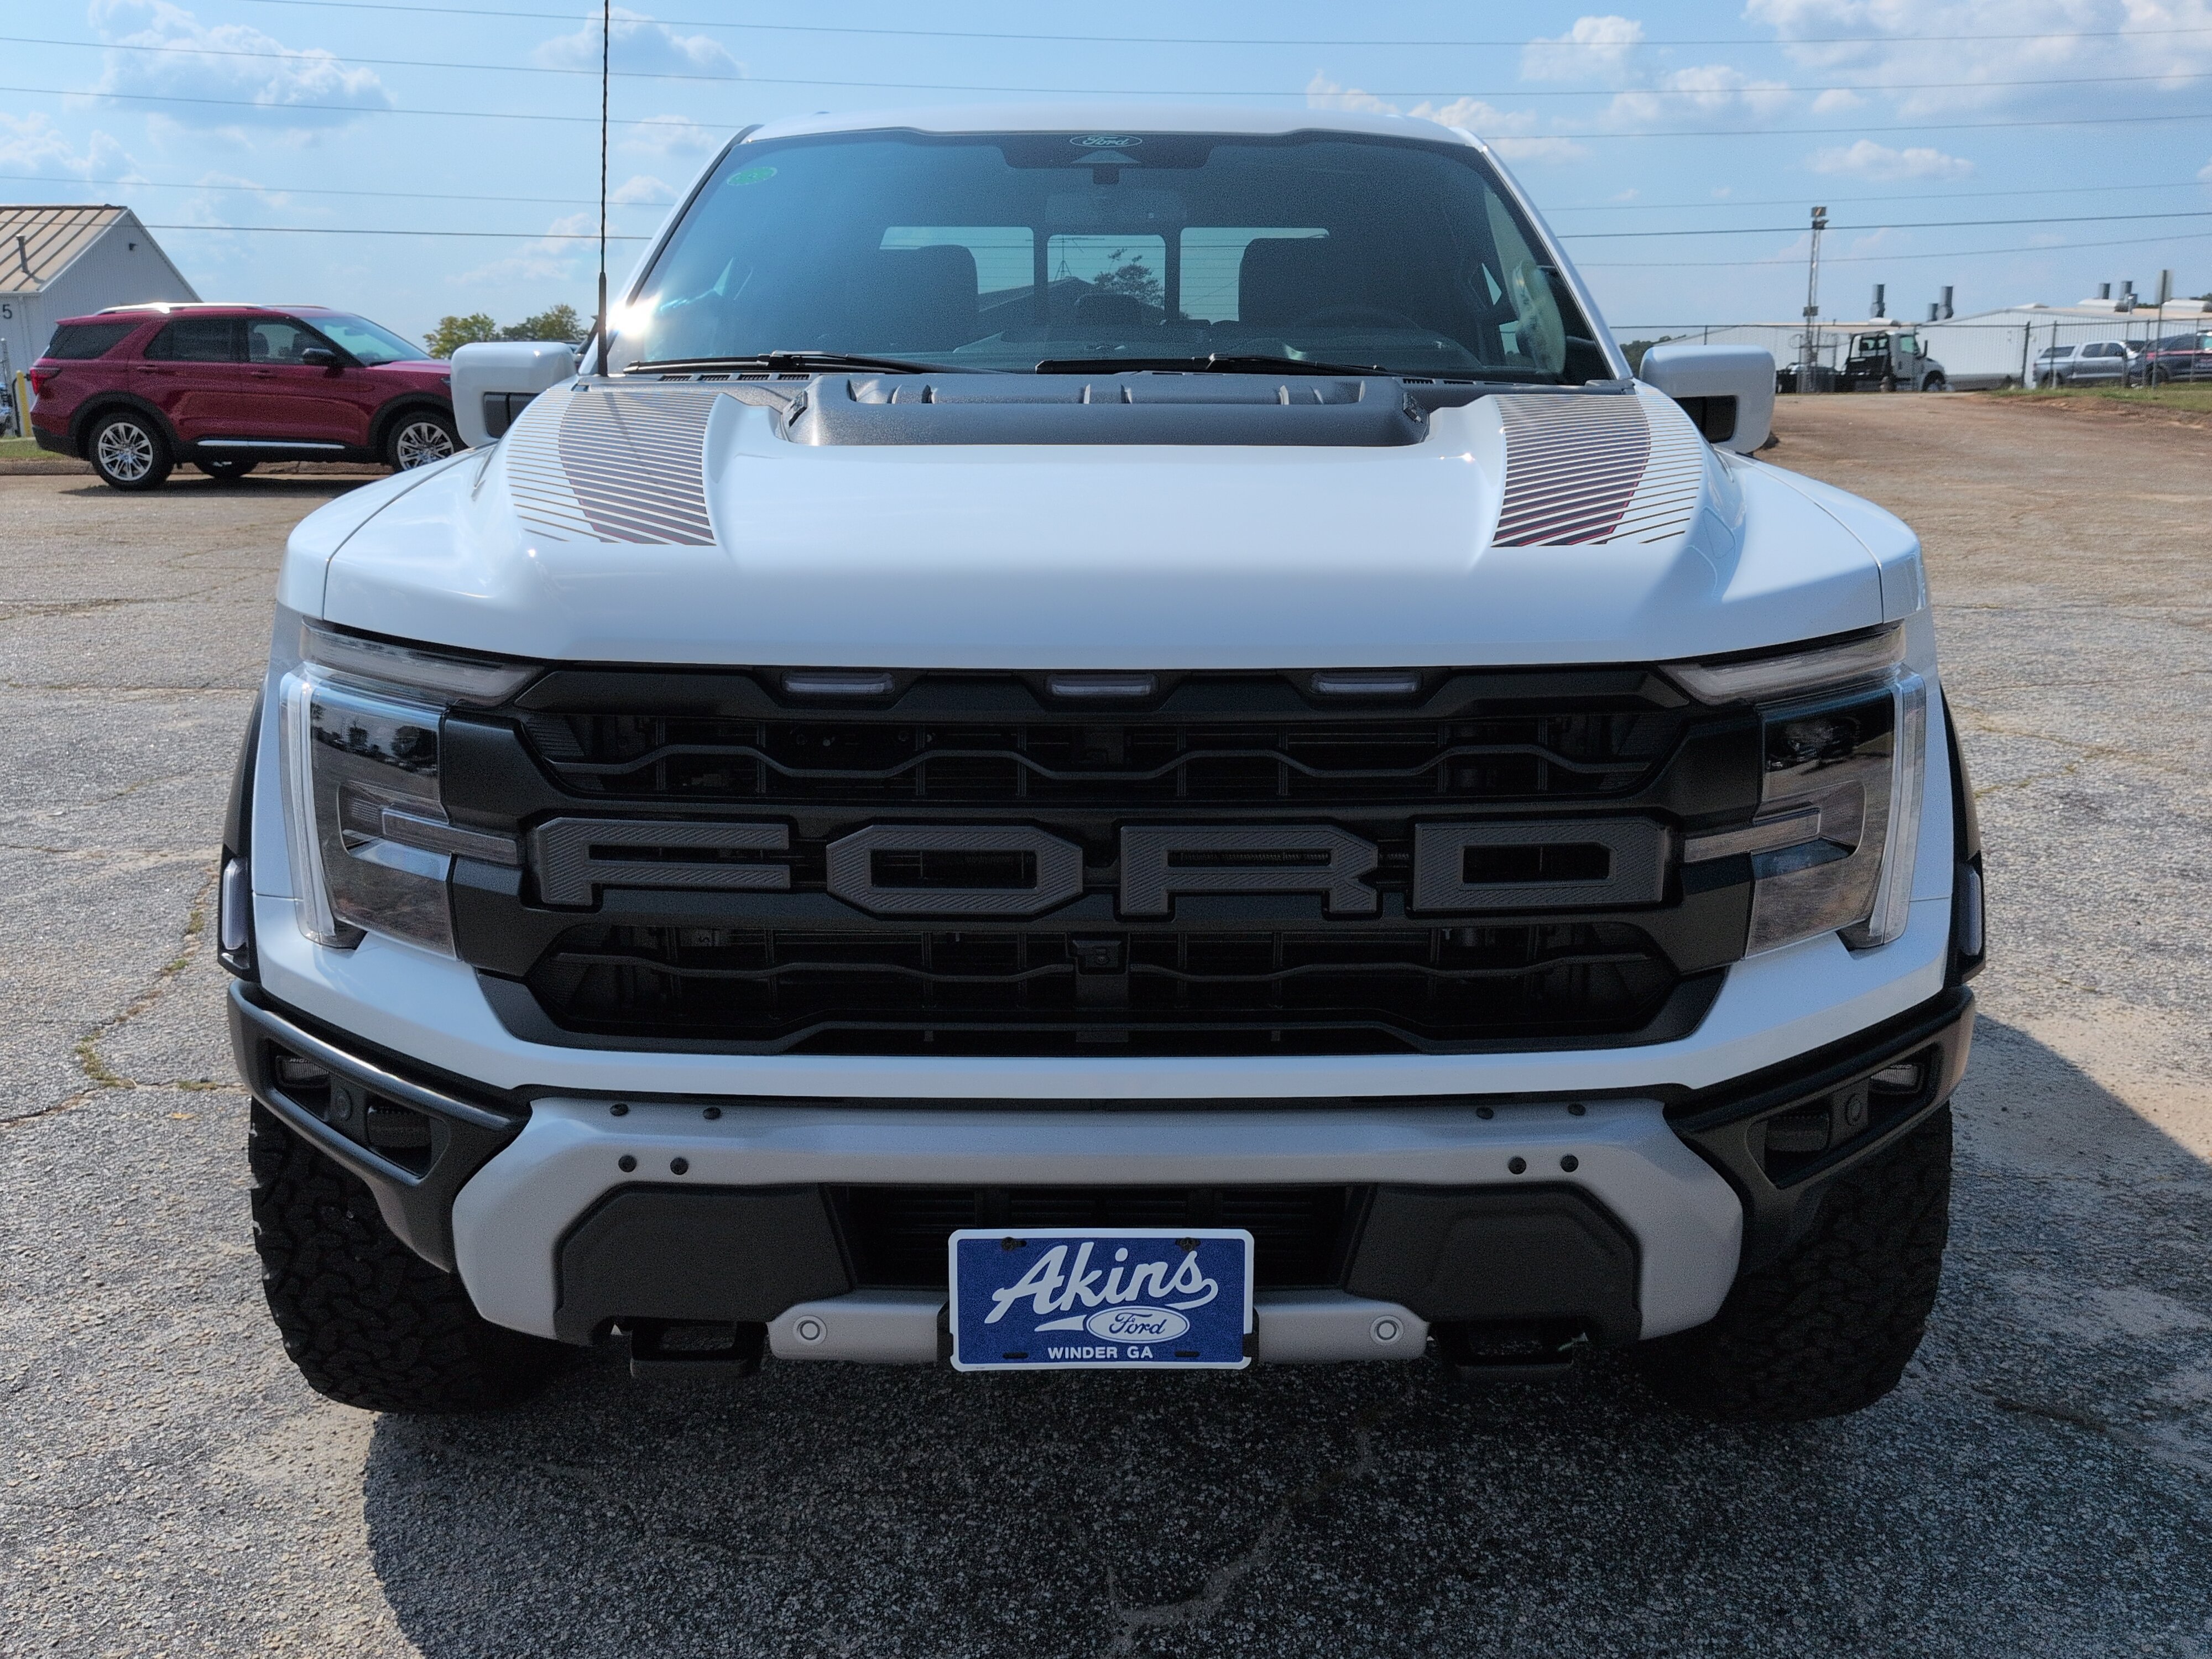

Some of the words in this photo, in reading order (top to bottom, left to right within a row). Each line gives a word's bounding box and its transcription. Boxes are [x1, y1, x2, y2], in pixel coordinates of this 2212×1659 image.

[1082, 136, 1129, 145] Ford
[2, 304, 12, 319] 5
[535, 816, 1669, 918] FORD
[984, 1242, 1218, 1324] Akins
[1109, 1312, 1167, 1334] Ford
[1047, 1347, 1118, 1359] WINDER
[1126, 1346, 1154, 1359] GA
